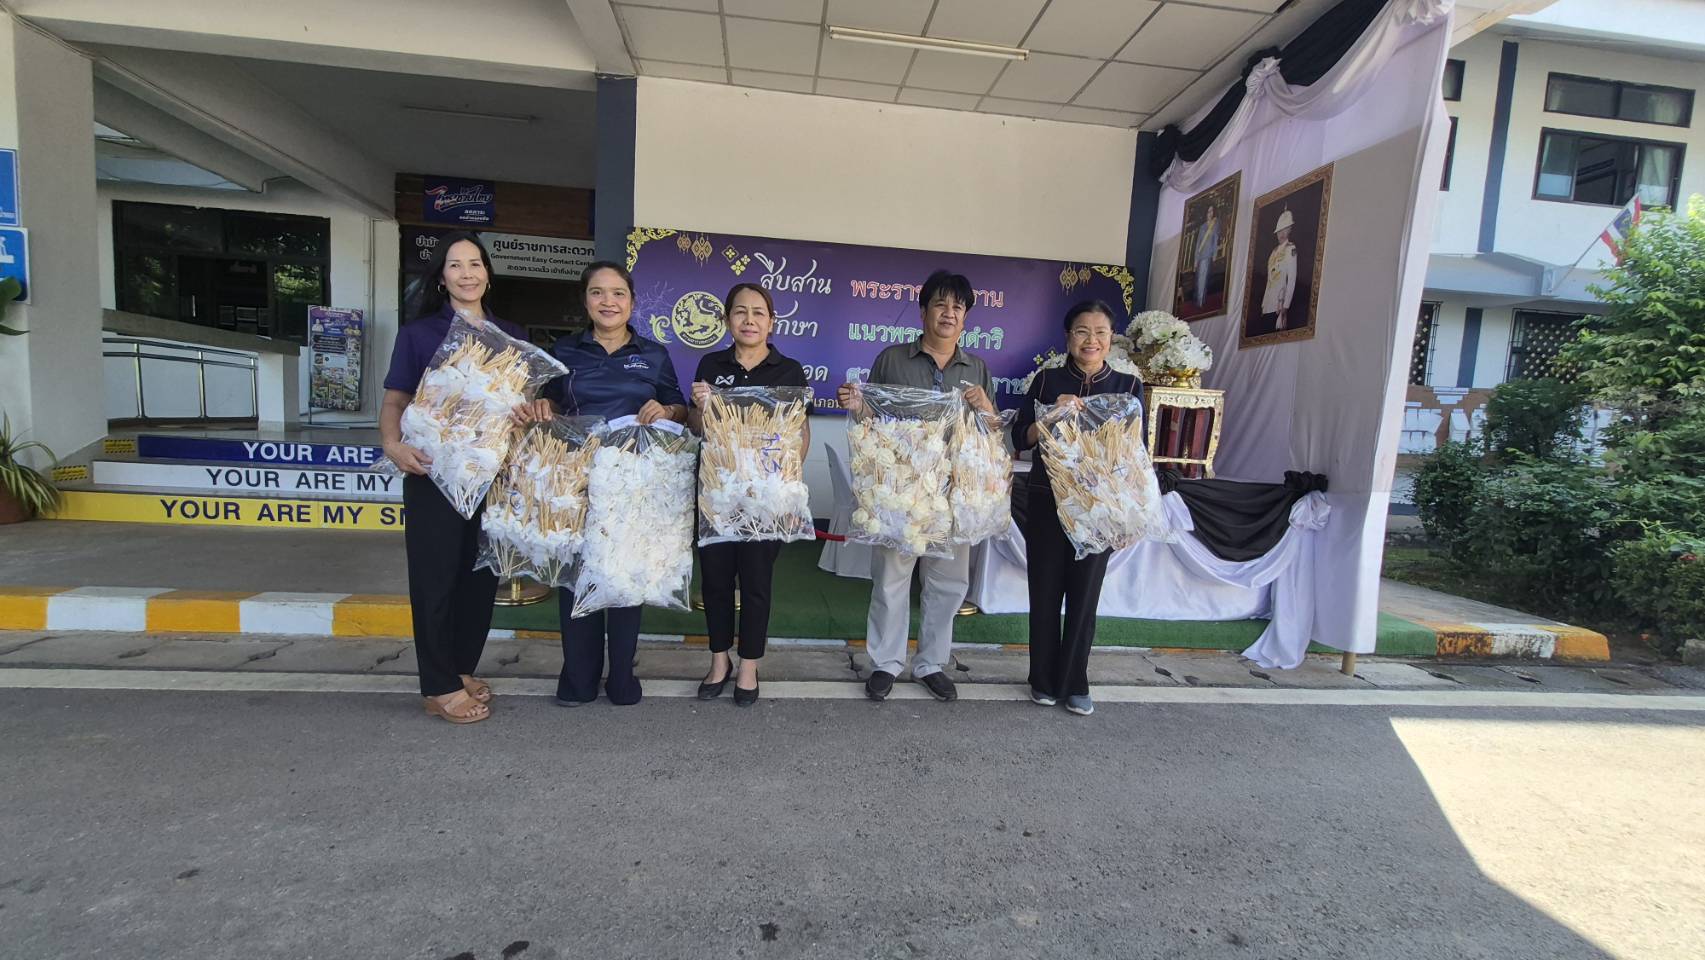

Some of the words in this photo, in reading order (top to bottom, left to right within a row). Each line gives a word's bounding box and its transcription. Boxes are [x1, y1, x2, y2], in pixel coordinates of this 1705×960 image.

[493, 238, 595, 257] ศูนย์ราชการสะดวก
[532, 256, 548, 264] Easy
[549, 257, 574, 265] Contact
[754, 252, 832, 295] สืบสาน
[243, 442, 313, 461] YOUR
[326, 447, 374, 463] ARE
[206, 468, 280, 488] YOUR
[295, 472, 346, 490] ARE
[357, 474, 394, 492] MY
[160, 499, 241, 520] YOUR
[257, 503, 312, 522] ARE
[323, 505, 364, 524] MY
